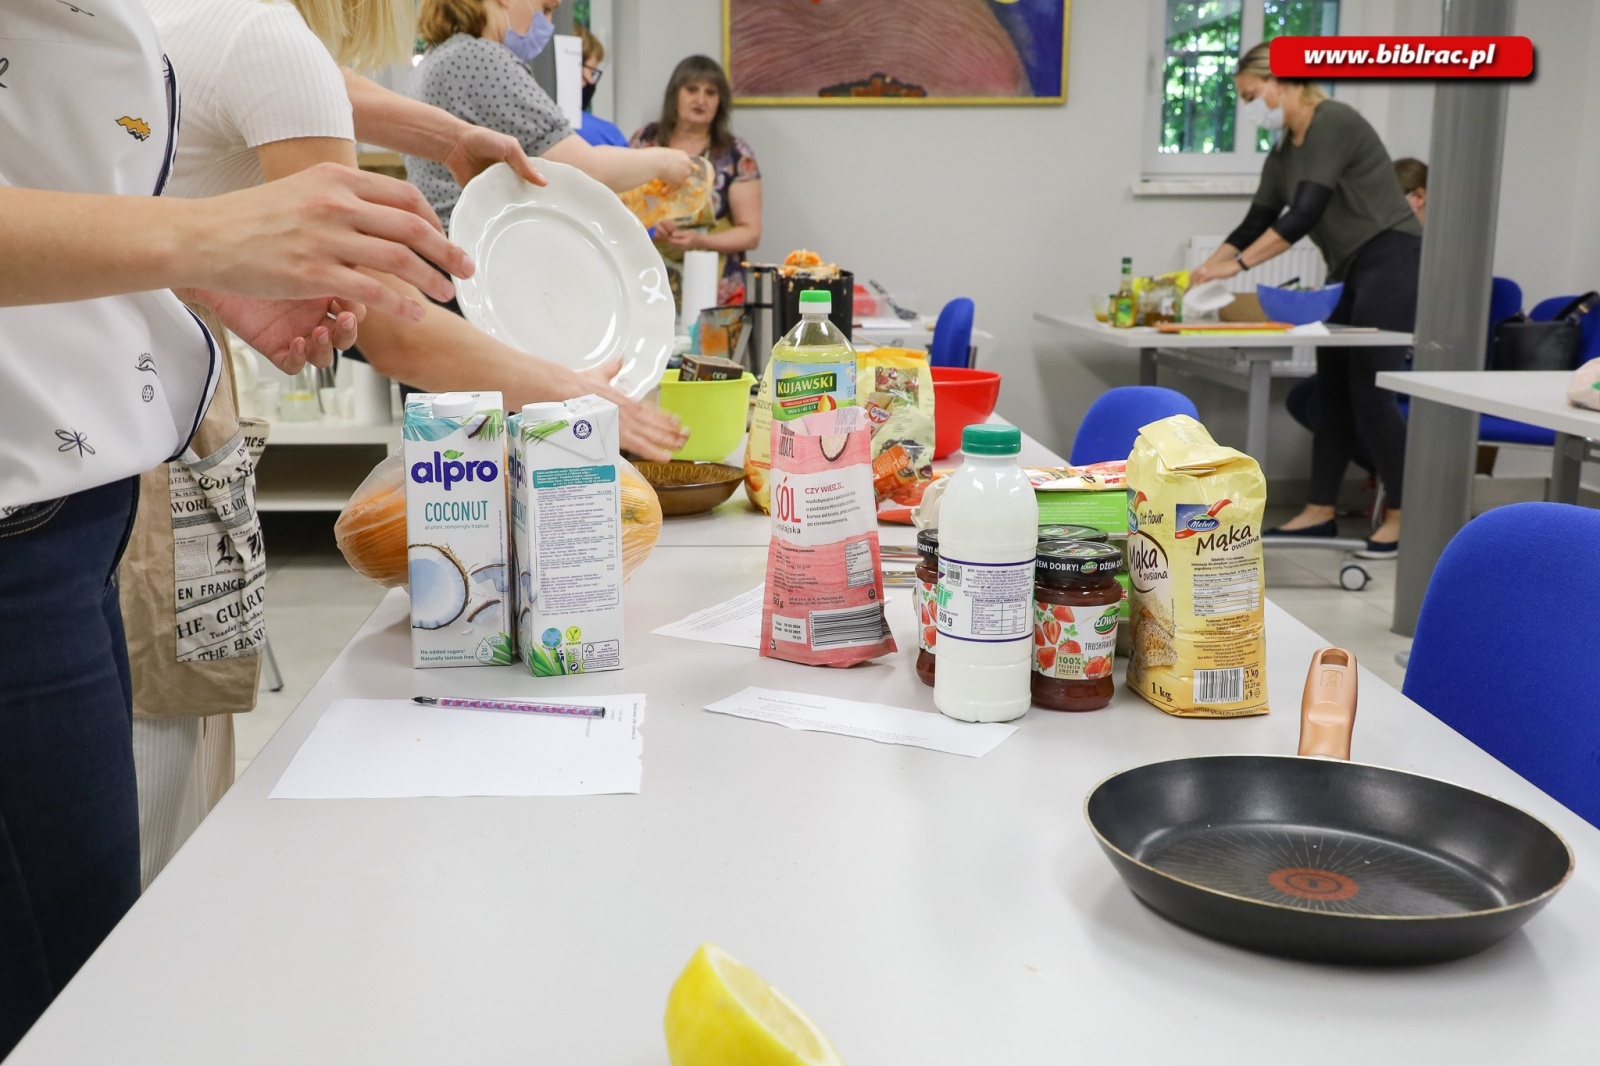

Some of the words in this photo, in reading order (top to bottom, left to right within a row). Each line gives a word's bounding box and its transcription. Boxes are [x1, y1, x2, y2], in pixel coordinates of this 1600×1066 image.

[777, 376, 833, 395] KUJAWSKI
[411, 451, 498, 491] alpro
[776, 476, 801, 523] SÓL
[425, 500, 488, 522] COCONUT
[1190, 520, 1215, 528] Melvit
[1195, 525, 1252, 555] Mąka
[1231, 535, 1260, 552] owsiana
[1049, 562, 1079, 572] DOBRY!
[1100, 560, 1116, 571] DŻEM
[1129, 540, 1158, 578] Mąka
[1143, 570, 1168, 581] owsiana
[178, 587, 193, 600] EN
[210, 624, 237, 639] Tuesday
[1058, 656, 1081, 665] 100%
[1251, 669, 1259, 678] kg
[1152, 682, 1156, 694] 1
[1159, 686, 1172, 702] kg
